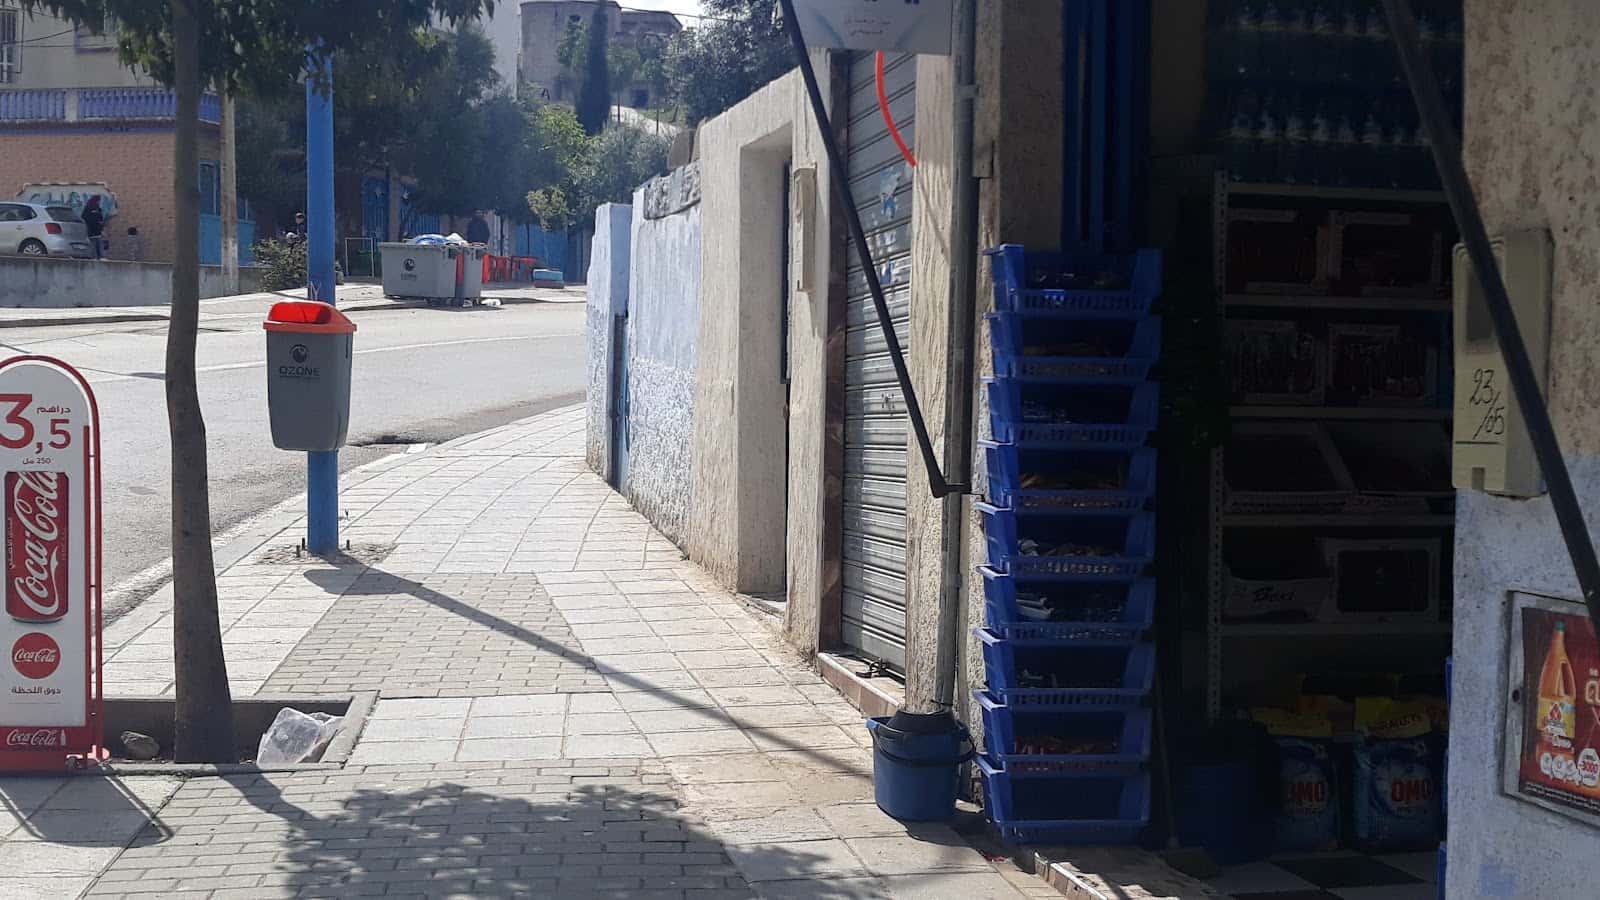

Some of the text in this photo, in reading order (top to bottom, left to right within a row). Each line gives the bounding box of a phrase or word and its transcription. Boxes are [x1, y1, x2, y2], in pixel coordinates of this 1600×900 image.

[279, 366, 321, 377] OZONE
[36, 404, 71, 415] دراهم
[1391, 778, 1432, 802] OMO
